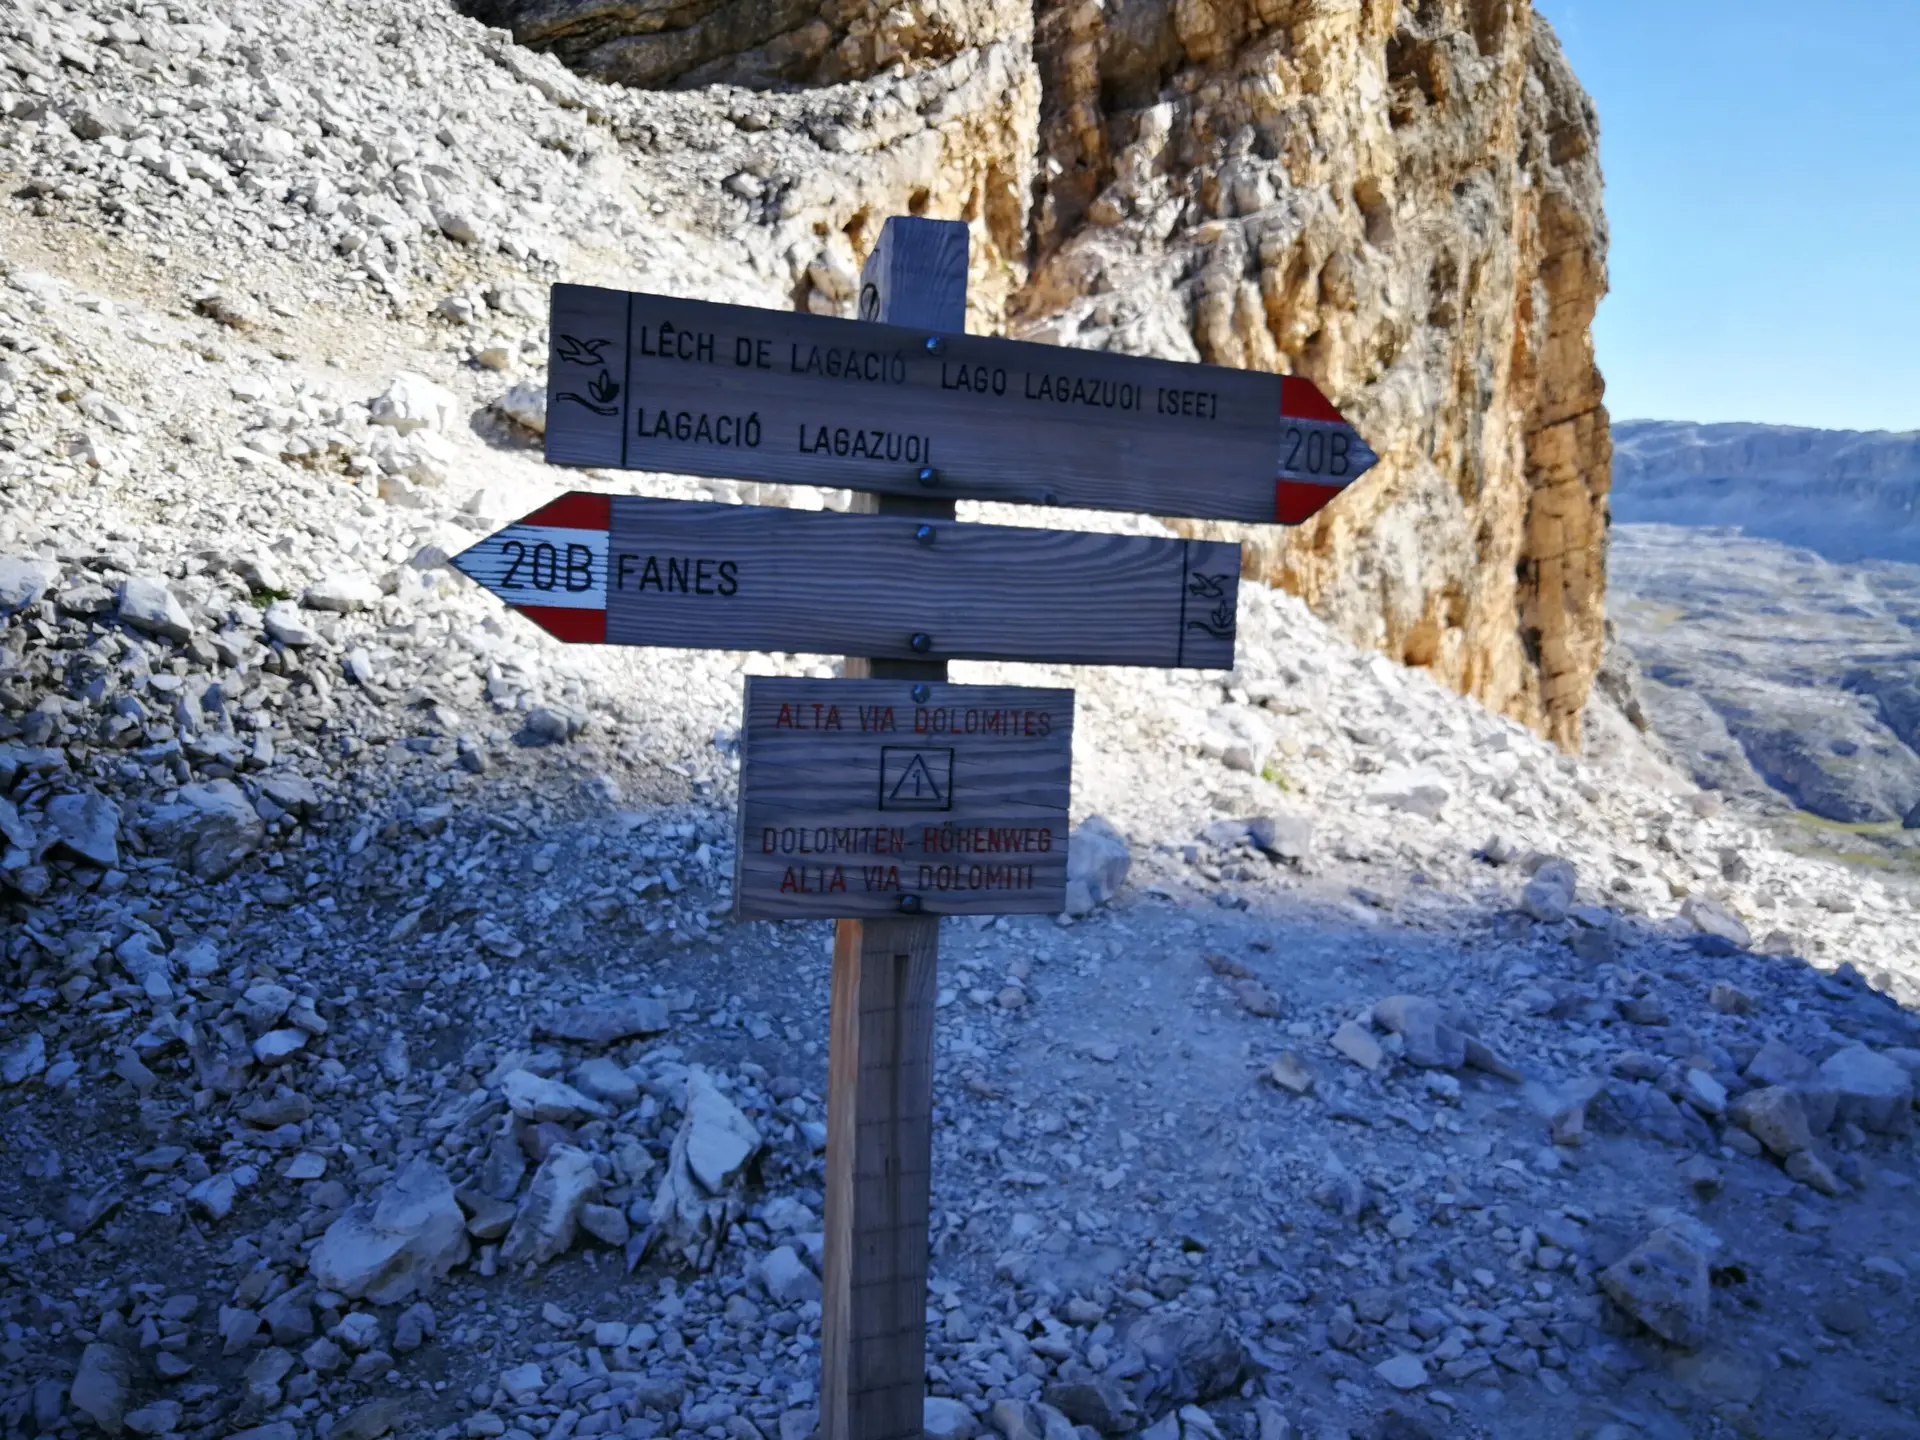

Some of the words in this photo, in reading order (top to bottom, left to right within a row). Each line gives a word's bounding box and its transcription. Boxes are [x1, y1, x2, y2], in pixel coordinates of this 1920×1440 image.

[735, 336, 773, 369] DE
[941, 361, 1007, 397] LAGO
[1024, 371, 1142, 411] LAGAZUOI
[1157, 387, 1218, 420] [SEE]
[637, 406, 762, 448] LAGACIÓ
[799, 423, 930, 464] LAGAZUOI
[1284, 426, 1350, 477] 20B
[501, 539, 593, 593] 20B
[616, 553, 739, 596] FANES
[775, 702, 842, 731] ALTA
[858, 705, 897, 733] VIA
[914, 707, 1052, 737] DOLOMITES
[911, 768, 921, 797] 1
[922, 820, 1052, 854] HÖHENWEG
[779, 864, 848, 894] ALTA
[862, 865, 901, 893] VIA
[916, 864, 1035, 891] DOLOMITI
